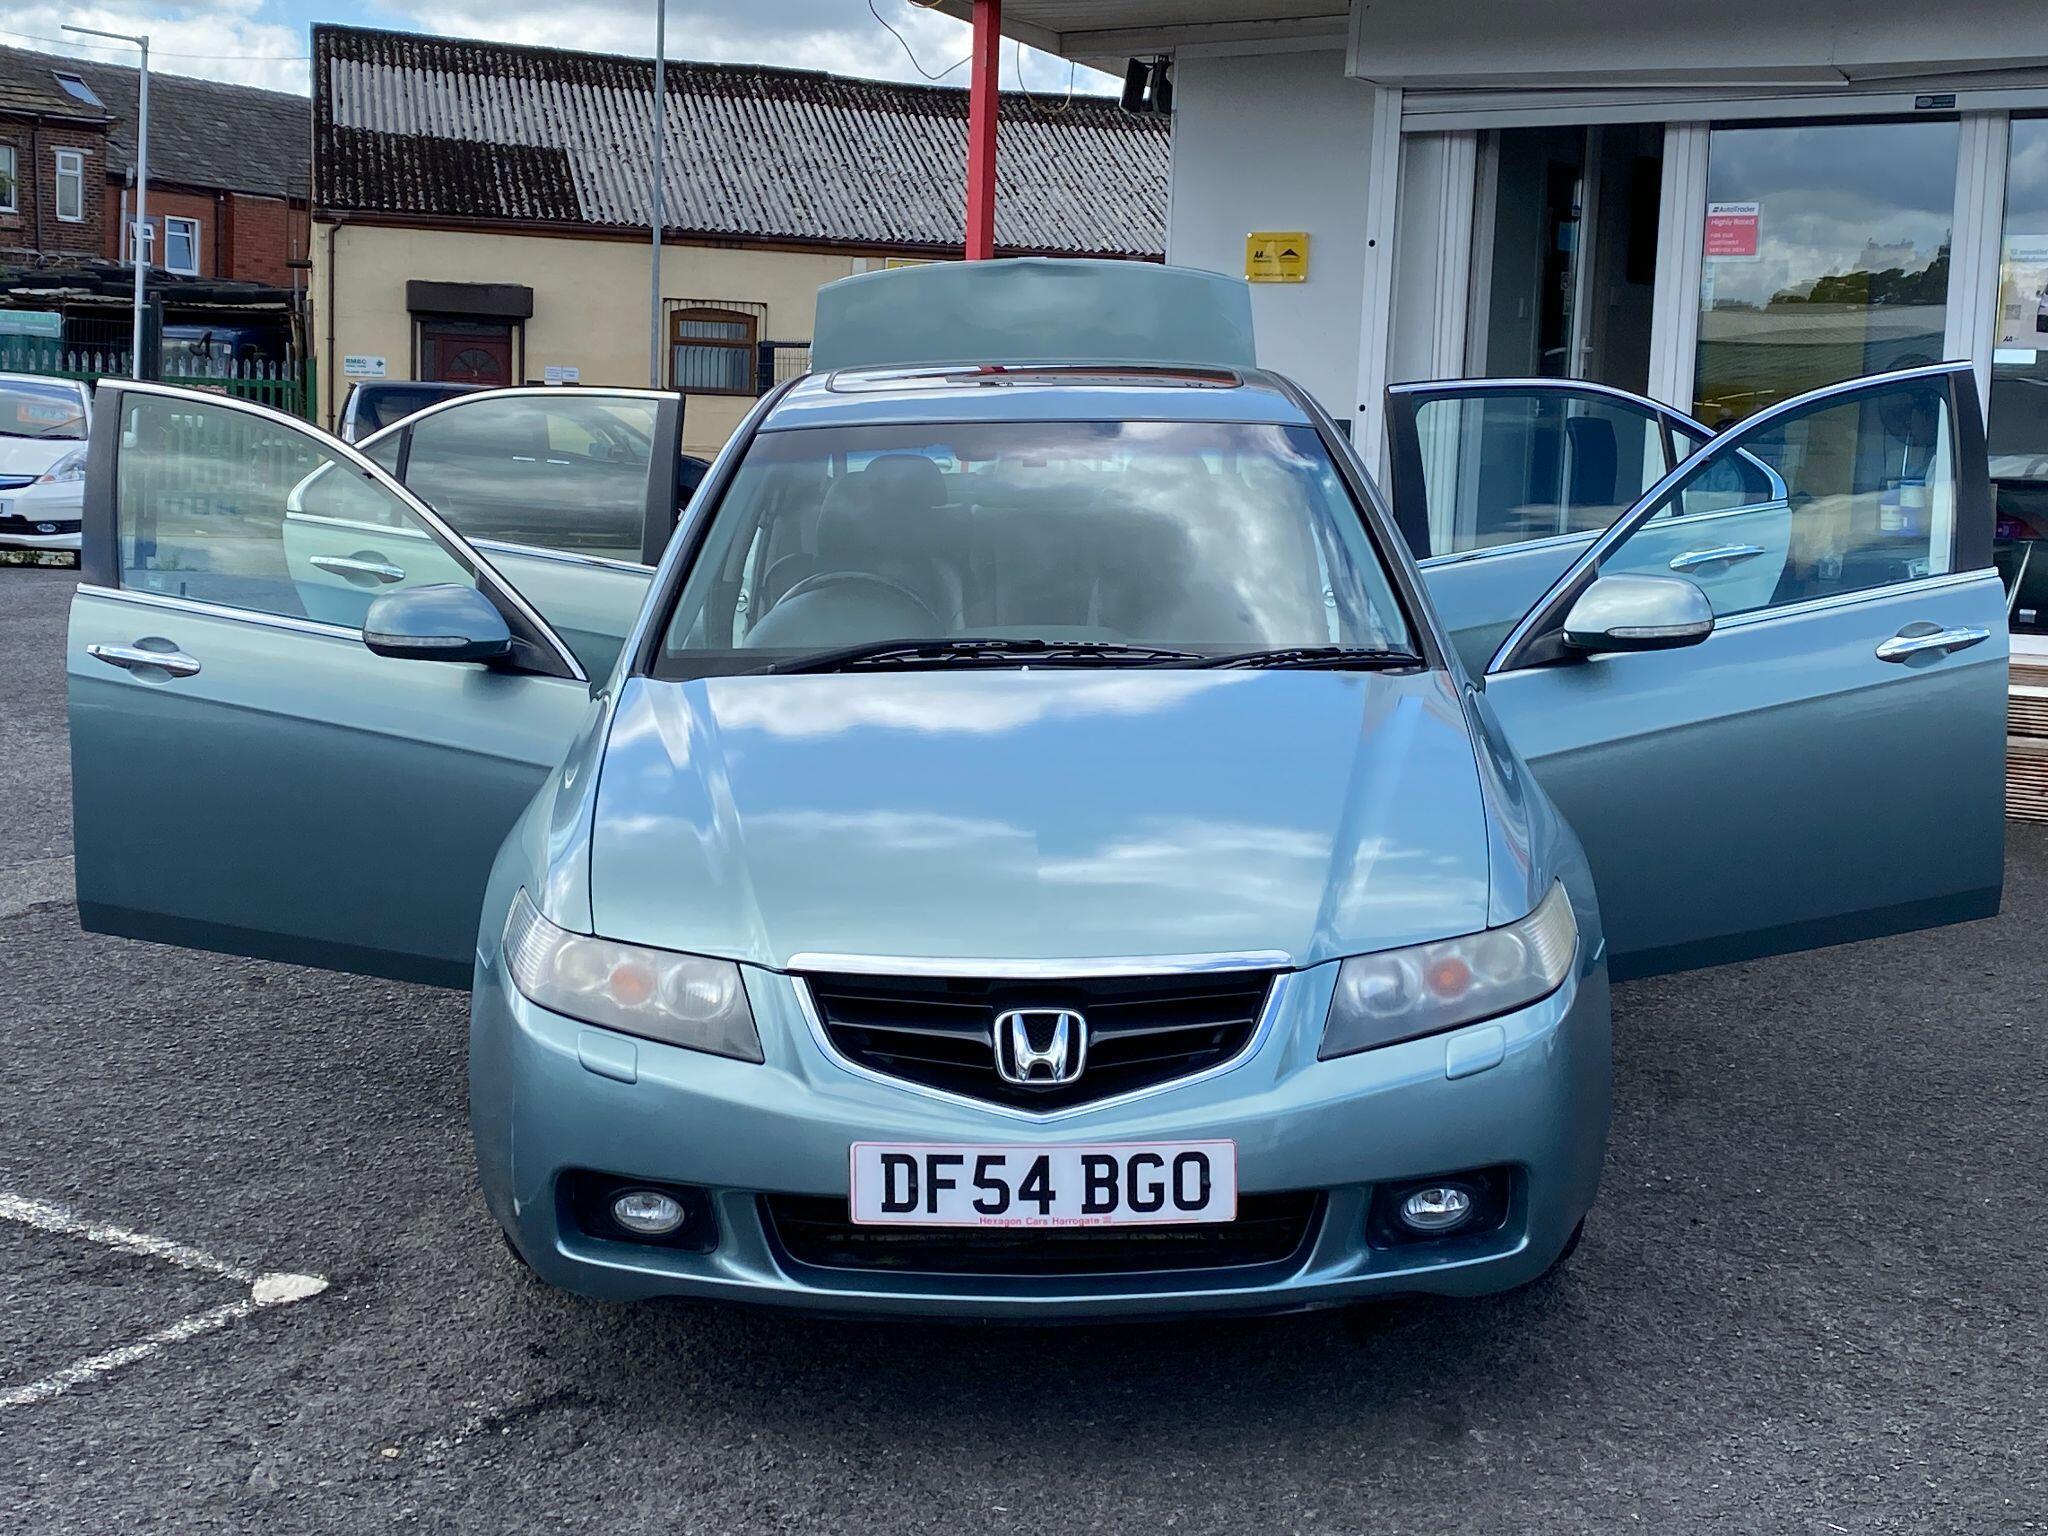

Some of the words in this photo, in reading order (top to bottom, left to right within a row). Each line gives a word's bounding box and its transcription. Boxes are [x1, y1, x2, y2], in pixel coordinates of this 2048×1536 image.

[1719, 205, 1756, 213] AutoTrader
[880, 1153, 1057, 1215] DF54
[1080, 1151, 1212, 1215] BGO
[979, 1217, 1022, 1228] Hexagon
[1025, 1217, 1048, 1226] Cars
[1052, 1216, 1100, 1228] Harrogate
